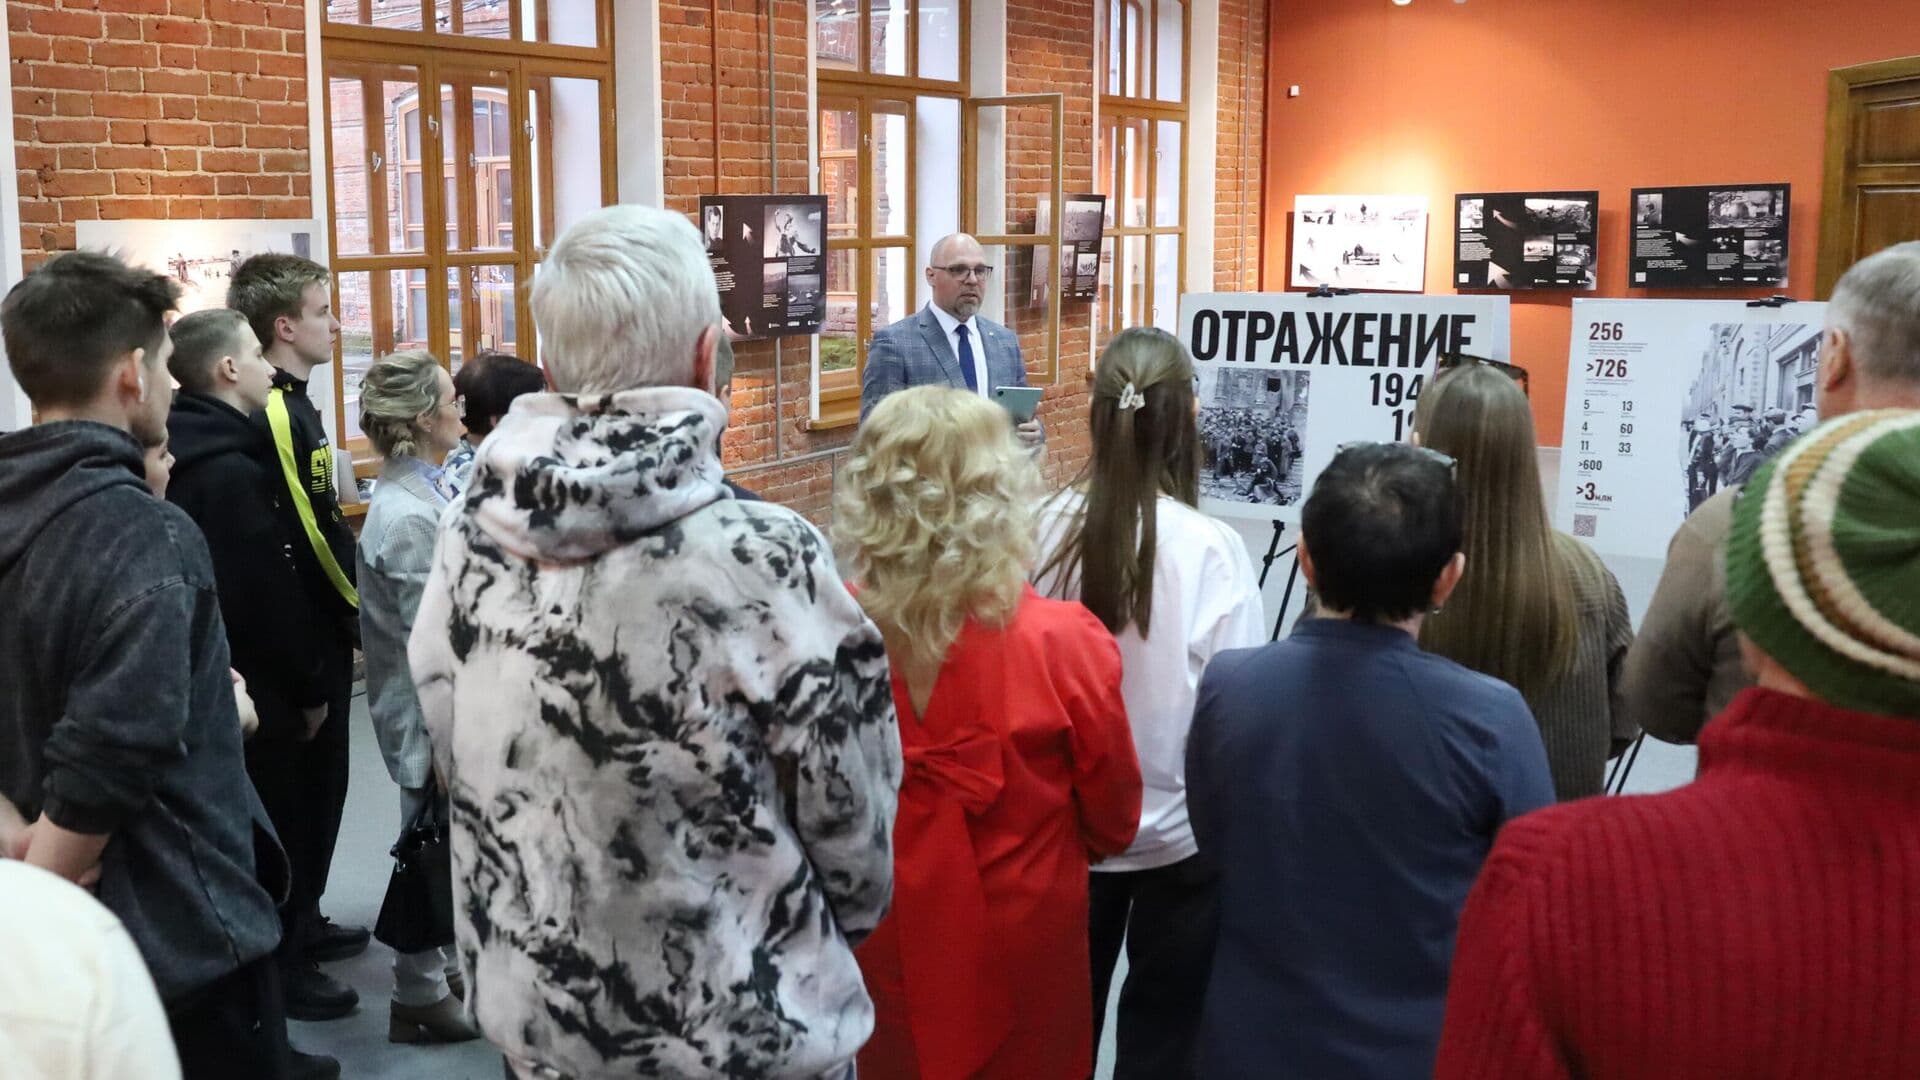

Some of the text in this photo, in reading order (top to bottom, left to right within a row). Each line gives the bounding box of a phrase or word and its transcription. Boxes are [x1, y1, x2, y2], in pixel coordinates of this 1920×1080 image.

[1589, 322, 1623, 341] 256
[1191, 309, 1476, 368] ОТРАЖЕНИЕ
[1586, 359, 1627, 378] >726
[1370, 372, 1424, 407] 194
[1583, 399, 1590, 410] 5
[1622, 400, 1633, 411] 13
[1581, 421, 1588, 432] 4
[1620, 423, 1633, 434] 60
[1581, 440, 1589, 451] 11
[1618, 442, 1631, 453] 33
[1578, 459, 1602, 471] >600
